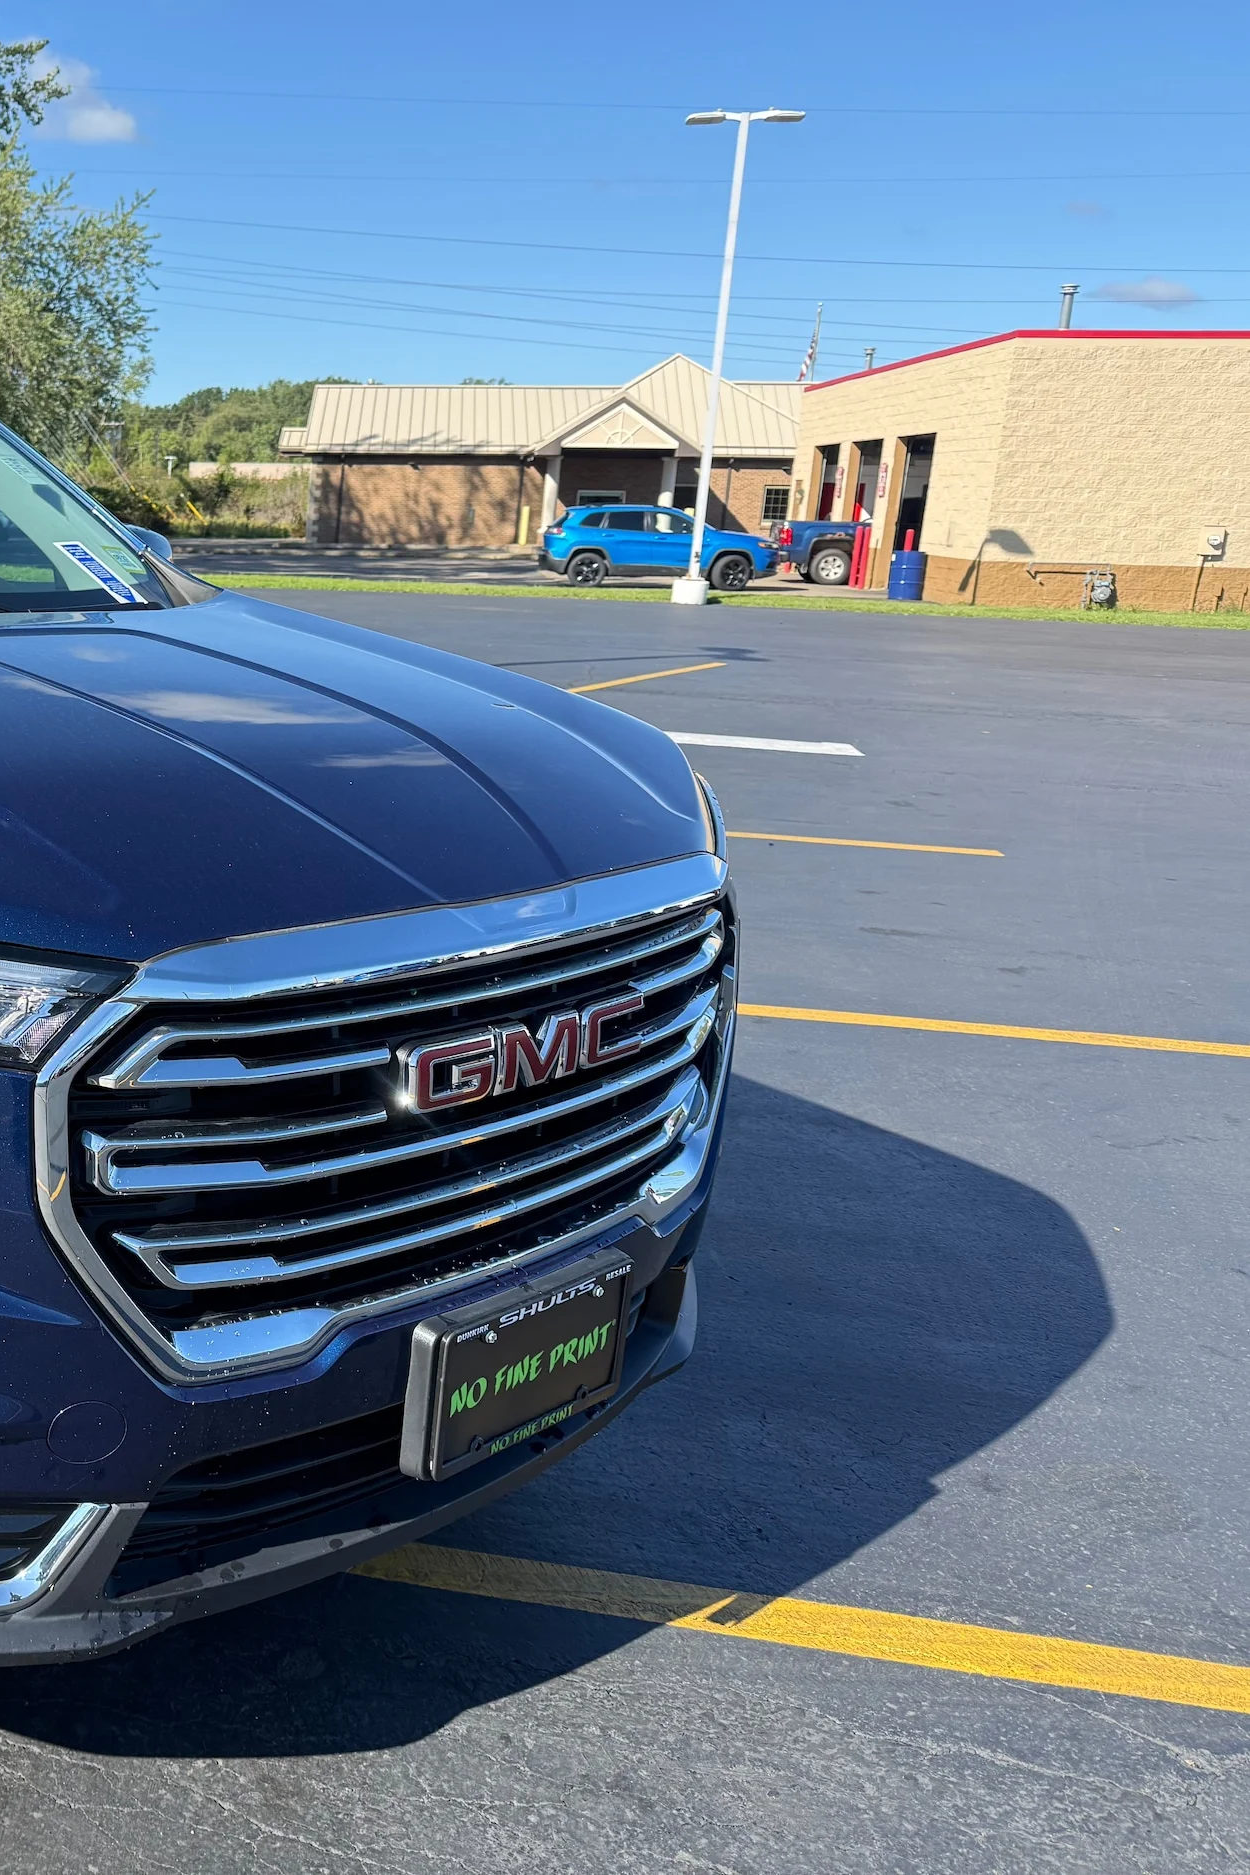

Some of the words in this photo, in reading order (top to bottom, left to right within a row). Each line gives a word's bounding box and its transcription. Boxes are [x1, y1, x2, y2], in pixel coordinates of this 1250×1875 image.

[395, 991, 645, 1115] GMC
[605, 1264, 632, 1281] RESALE
[498, 1277, 597, 1329] SHULTS
[456, 1323, 490, 1343] DUNKIRK
[449, 1376, 488, 1418] NO
[494, 1350, 545, 1396] FINE
[490, 1436, 510, 1455] NO
[513, 1421, 538, 1444] FINE
[541, 1403, 574, 1430] PRINT
